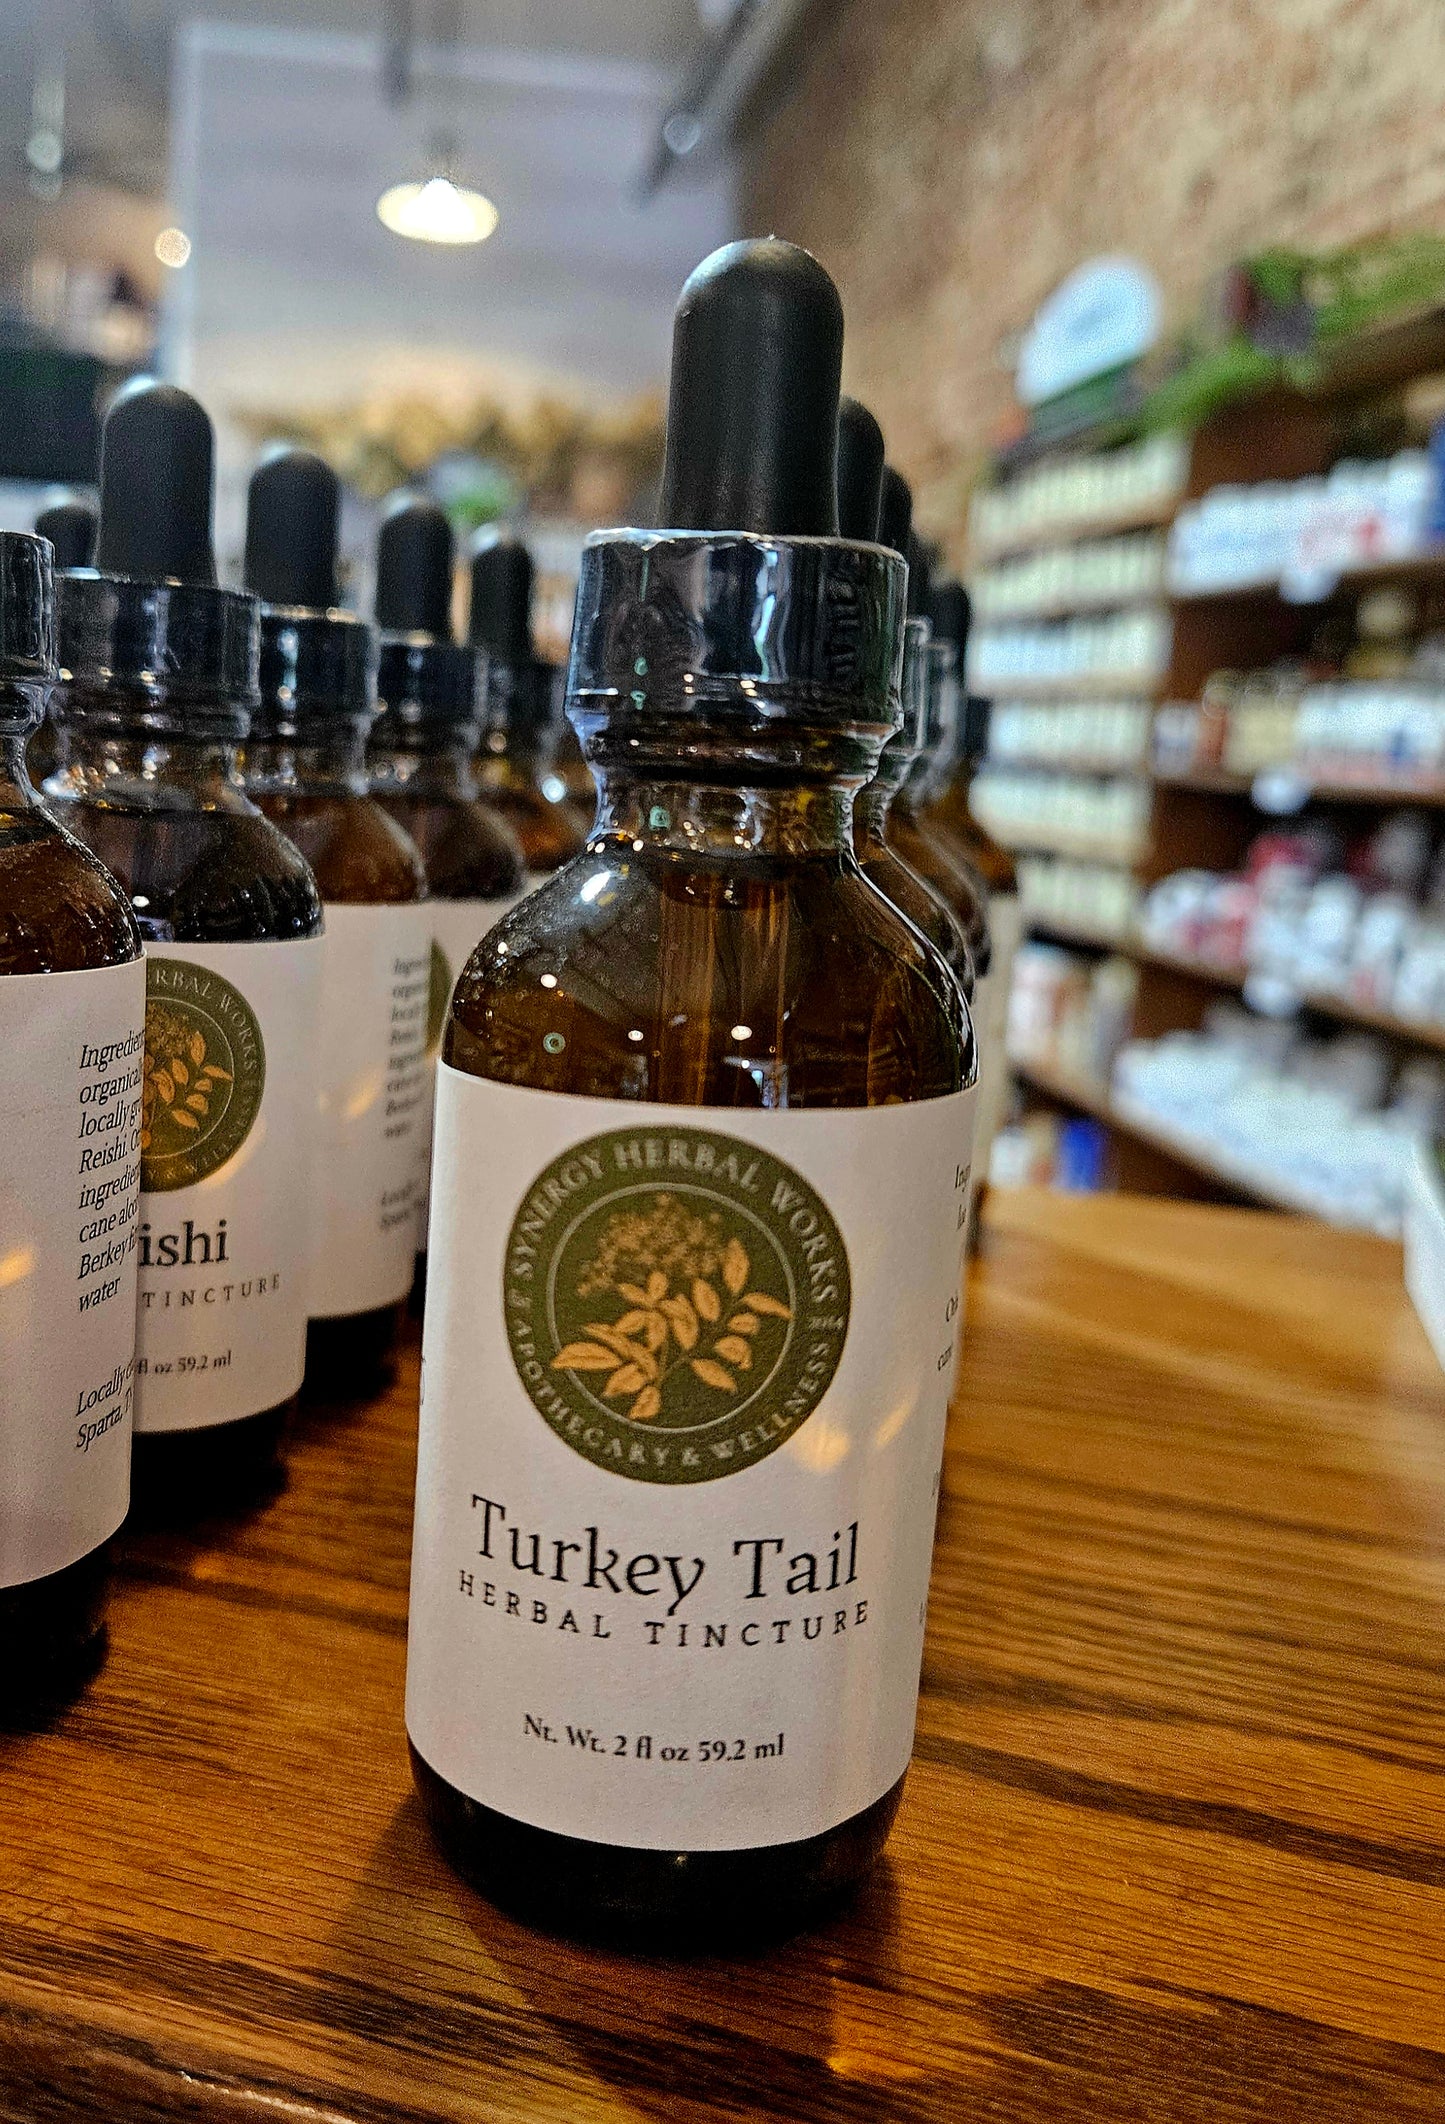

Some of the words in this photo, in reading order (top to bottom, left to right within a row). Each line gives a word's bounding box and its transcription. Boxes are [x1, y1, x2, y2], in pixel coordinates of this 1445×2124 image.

[155, 968, 212, 1000] RBAL
[78, 1099, 130, 1138] locally
[79, 1213, 117, 1243] cane
[511, 1150, 606, 1280] SYNERGY
[613, 1138, 760, 1194] HERBAL
[770, 1179, 839, 1303] WORKS
[78, 1238, 128, 1280] Berkey
[137, 1218, 230, 1267] ishi
[79, 1276, 120, 1312] water
[142, 1273, 280, 1308] TINCTURE
[154, 1363, 172, 1375] oz
[177, 1354, 208, 1373] 59.2
[213, 1350, 232, 1369] ml
[76, 1365, 126, 1417] Locally
[512, 1319, 669, 1467] APOTHECARY
[711, 1342, 832, 1460] WELLNESS
[471, 1493, 706, 1616] Turkey
[732, 1520, 860, 1600] Tail
[458, 1570, 612, 1639] HERBAL
[643, 1599, 869, 1648] TINCTURE
[612, 1734, 628, 1757] 2
[635, 1734, 653, 1760] fl
[660, 1746, 690, 1762] oz
[698, 1738, 746, 1762] 59.2
[754, 1732, 785, 1760] ml
